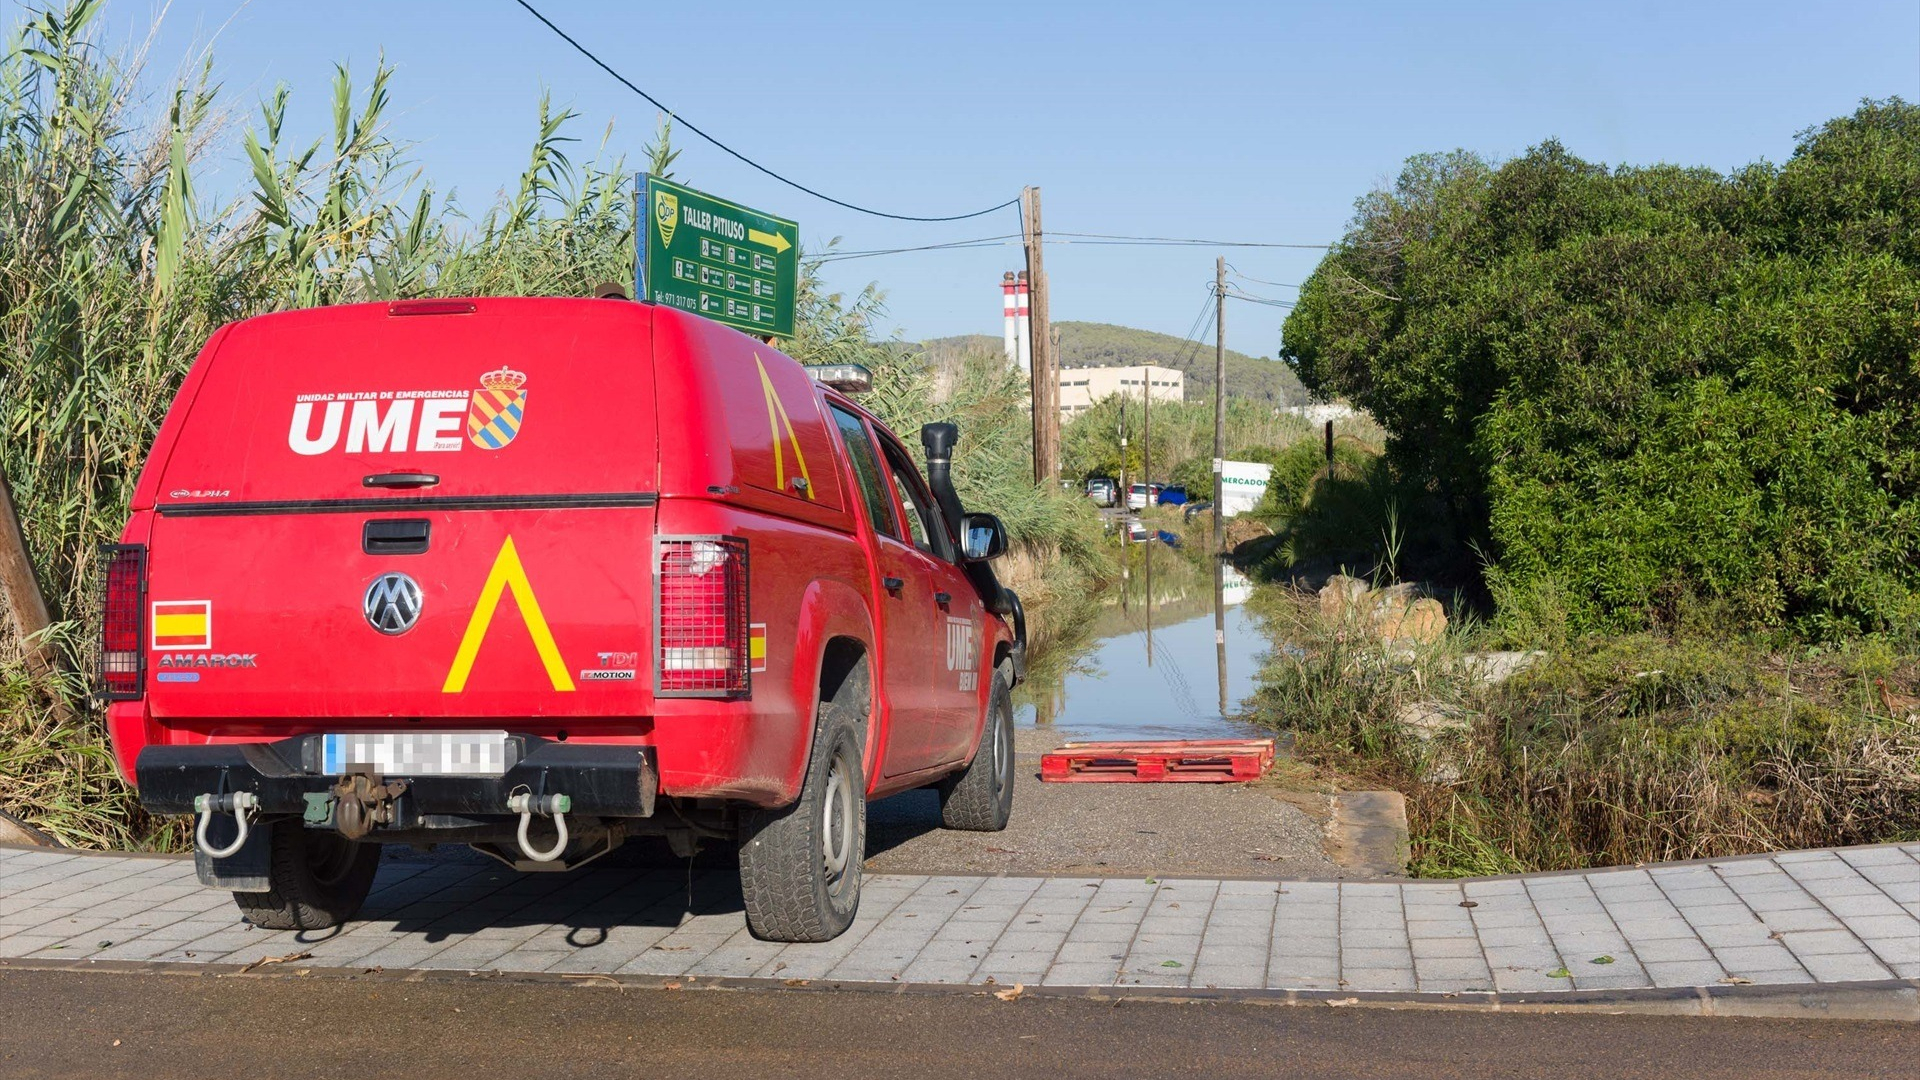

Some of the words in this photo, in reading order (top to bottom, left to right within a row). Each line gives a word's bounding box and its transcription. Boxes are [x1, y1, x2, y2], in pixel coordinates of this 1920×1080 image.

[683, 205, 711, 231] TALLER
[713, 215, 745, 241] PITIUSO
[665, 293, 674, 305] 971
[676, 295, 686, 307] 317
[687, 298, 697, 309] 075
[296, 393, 335, 402] UNIDAD
[337, 391, 377, 400] MILITAR
[380, 391, 393, 399] DE
[396, 390, 470, 399] EMERGENCIAS
[288, 399, 469, 456] UME
[190, 489, 230, 498] ALPHA
[946, 624, 973, 671] UME
[158, 652, 258, 668] AMAROK
[597, 651, 638, 667] TDI
